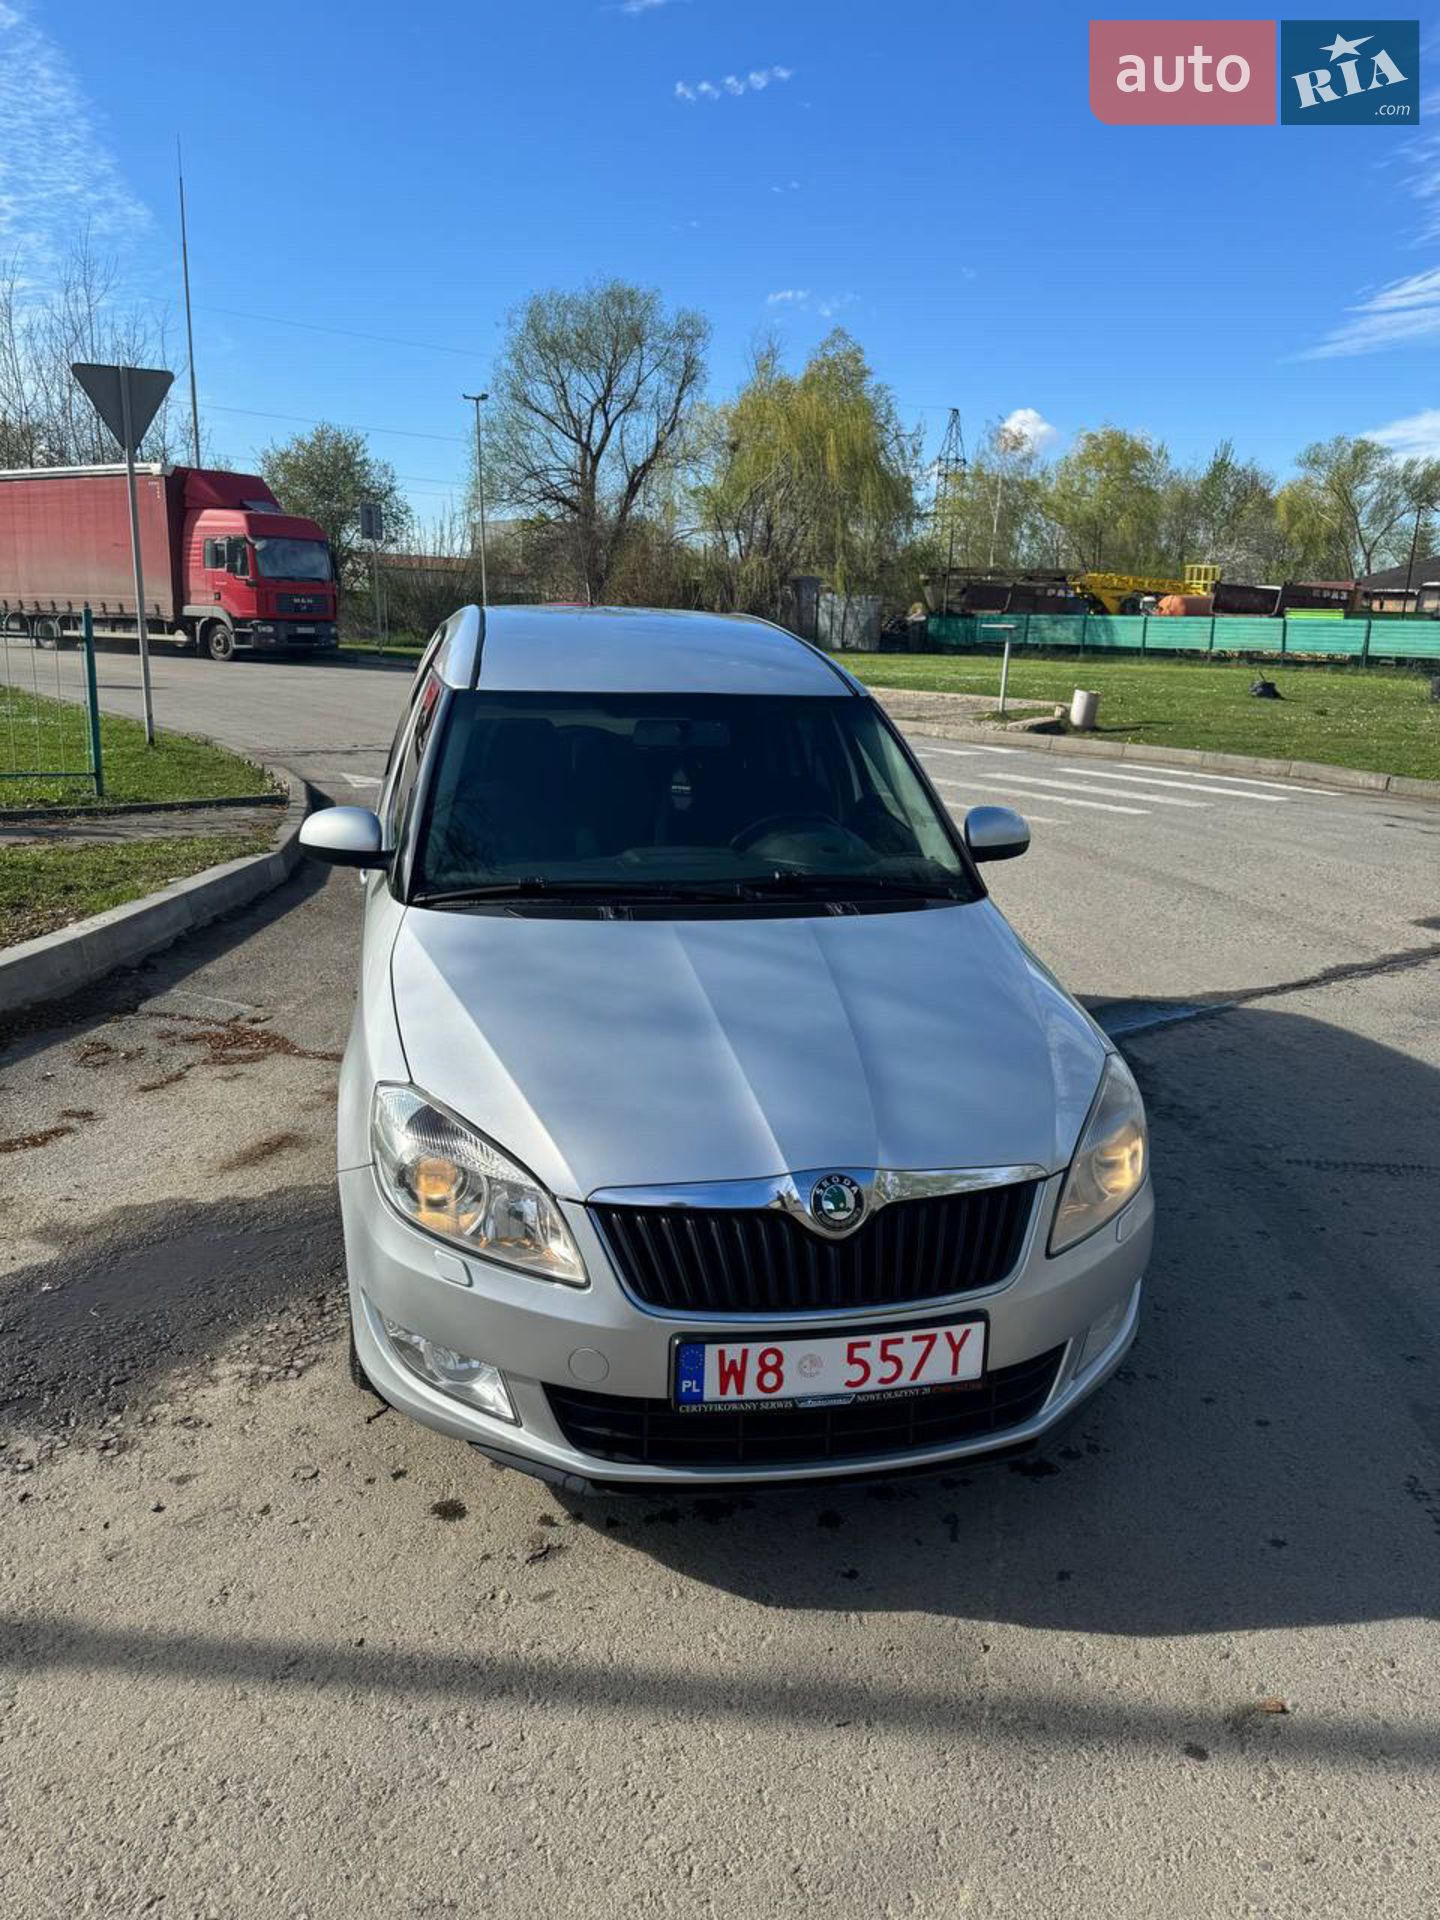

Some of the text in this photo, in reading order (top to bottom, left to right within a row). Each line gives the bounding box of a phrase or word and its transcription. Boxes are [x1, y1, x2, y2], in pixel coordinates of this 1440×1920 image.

[717, 1328, 972, 1396] W8 557Y
[681, 1380, 701, 1393] PL
